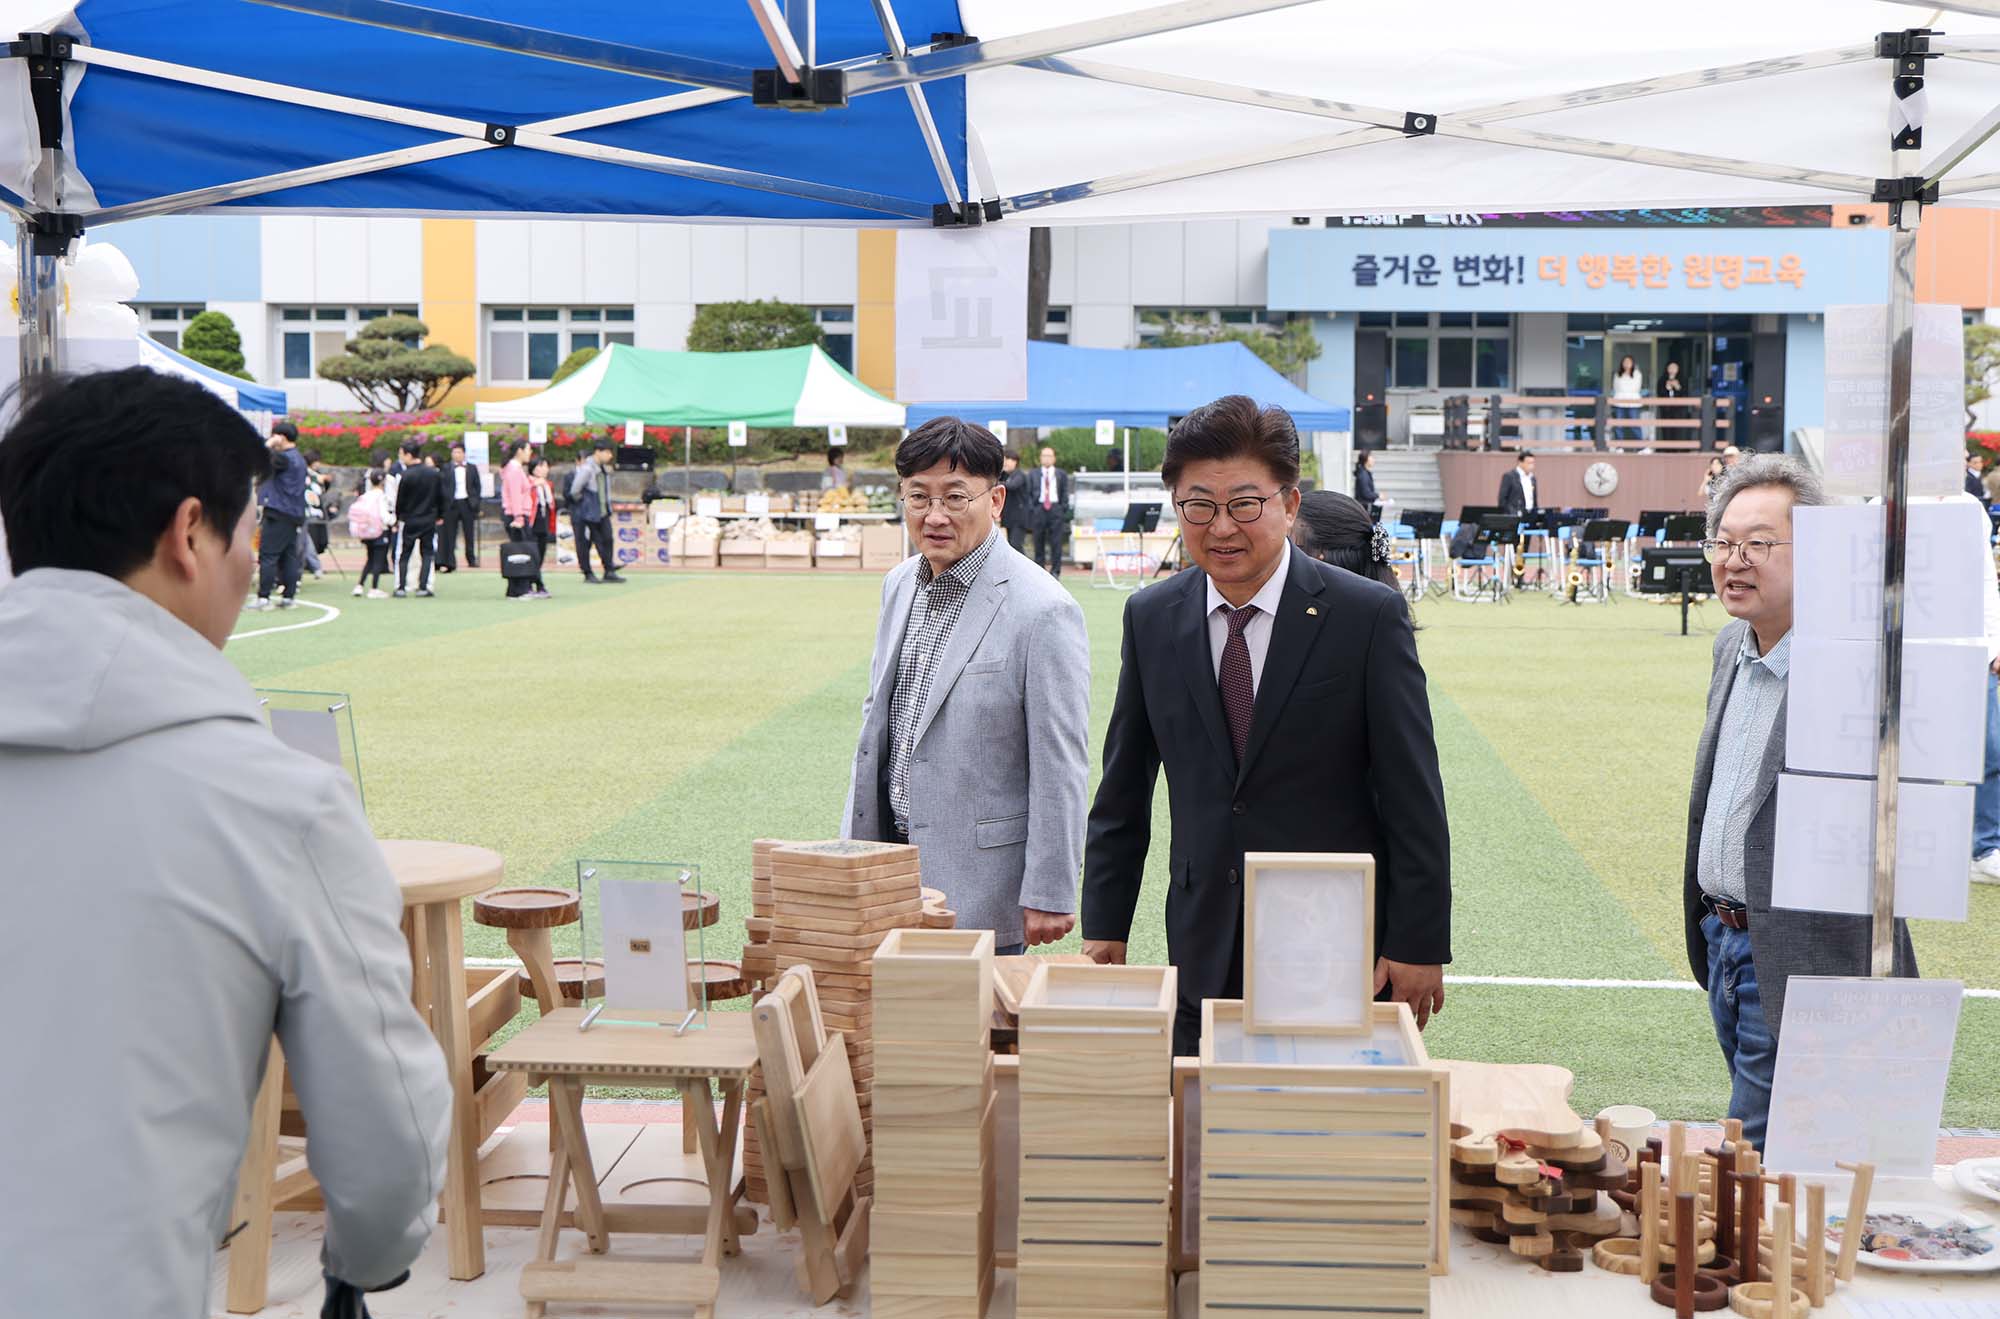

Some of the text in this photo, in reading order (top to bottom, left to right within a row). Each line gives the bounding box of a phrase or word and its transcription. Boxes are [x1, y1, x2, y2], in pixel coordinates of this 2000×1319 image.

[1352, 253, 1806, 288] 즐거운 변화! 더 행복한 원명교육
